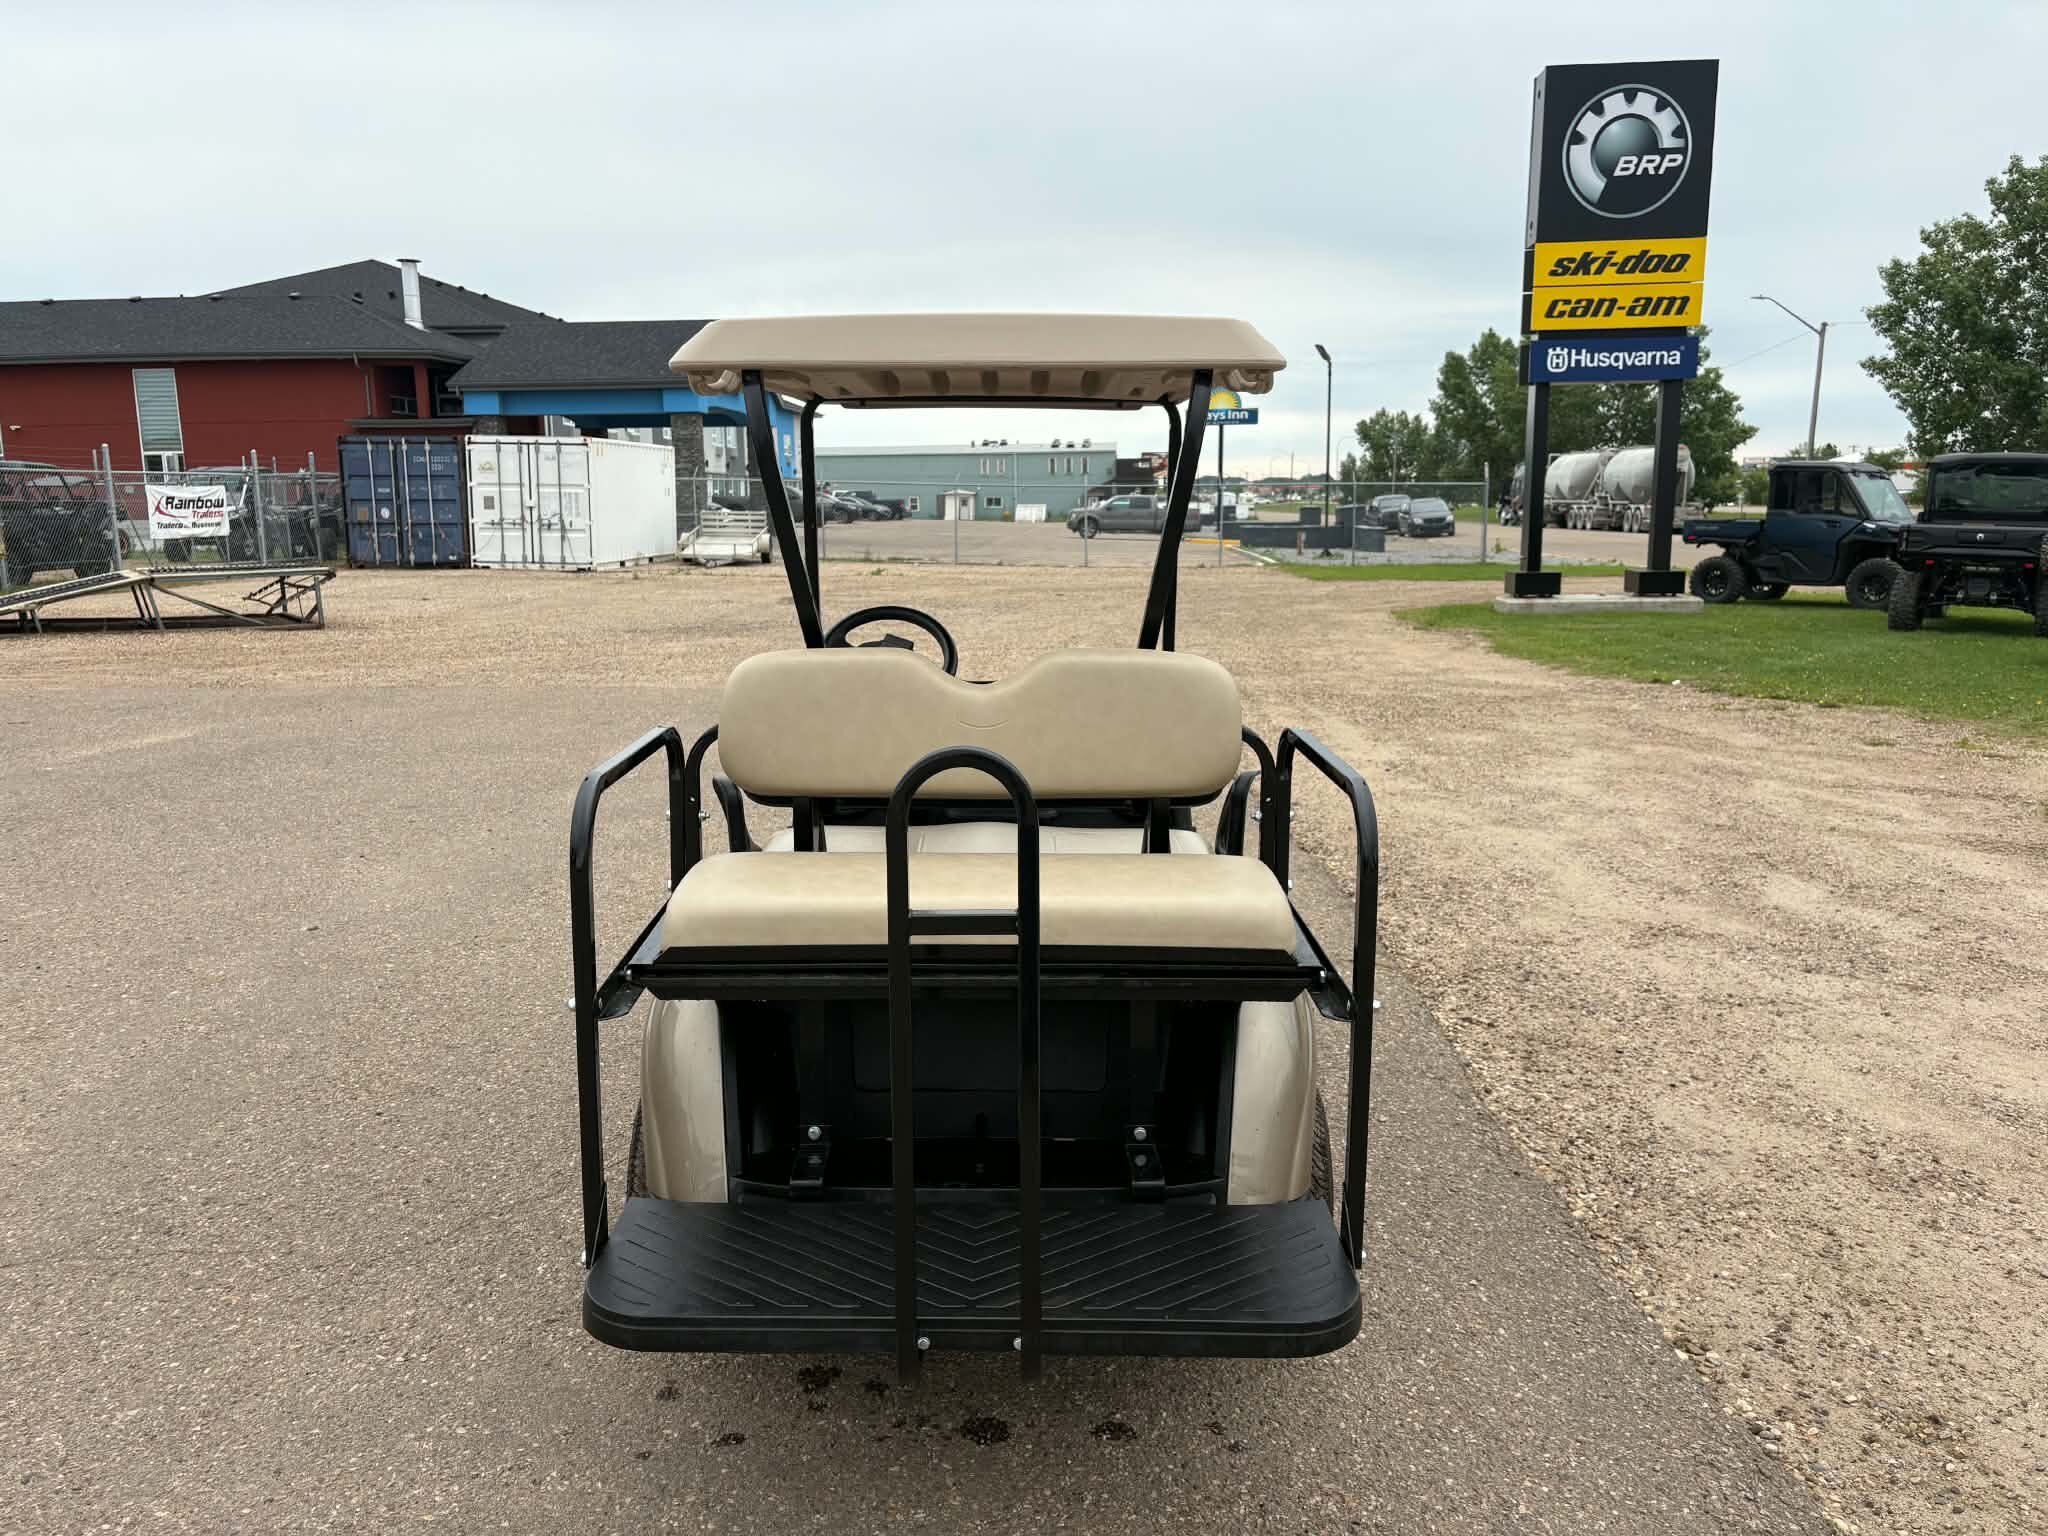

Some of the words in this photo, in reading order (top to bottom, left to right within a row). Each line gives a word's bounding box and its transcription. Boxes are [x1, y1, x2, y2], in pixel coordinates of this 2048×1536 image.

[1613, 153, 1684, 177] BRP
[1548, 249, 1691, 277] ski-doo
[1545, 294, 1688, 319] can-am
[1569, 347, 1681, 370] Husqvarna
[1207, 410, 1226, 421] ays
[1228, 410, 1249, 419] Inn
[165, 496, 224, 510] Rainbow
